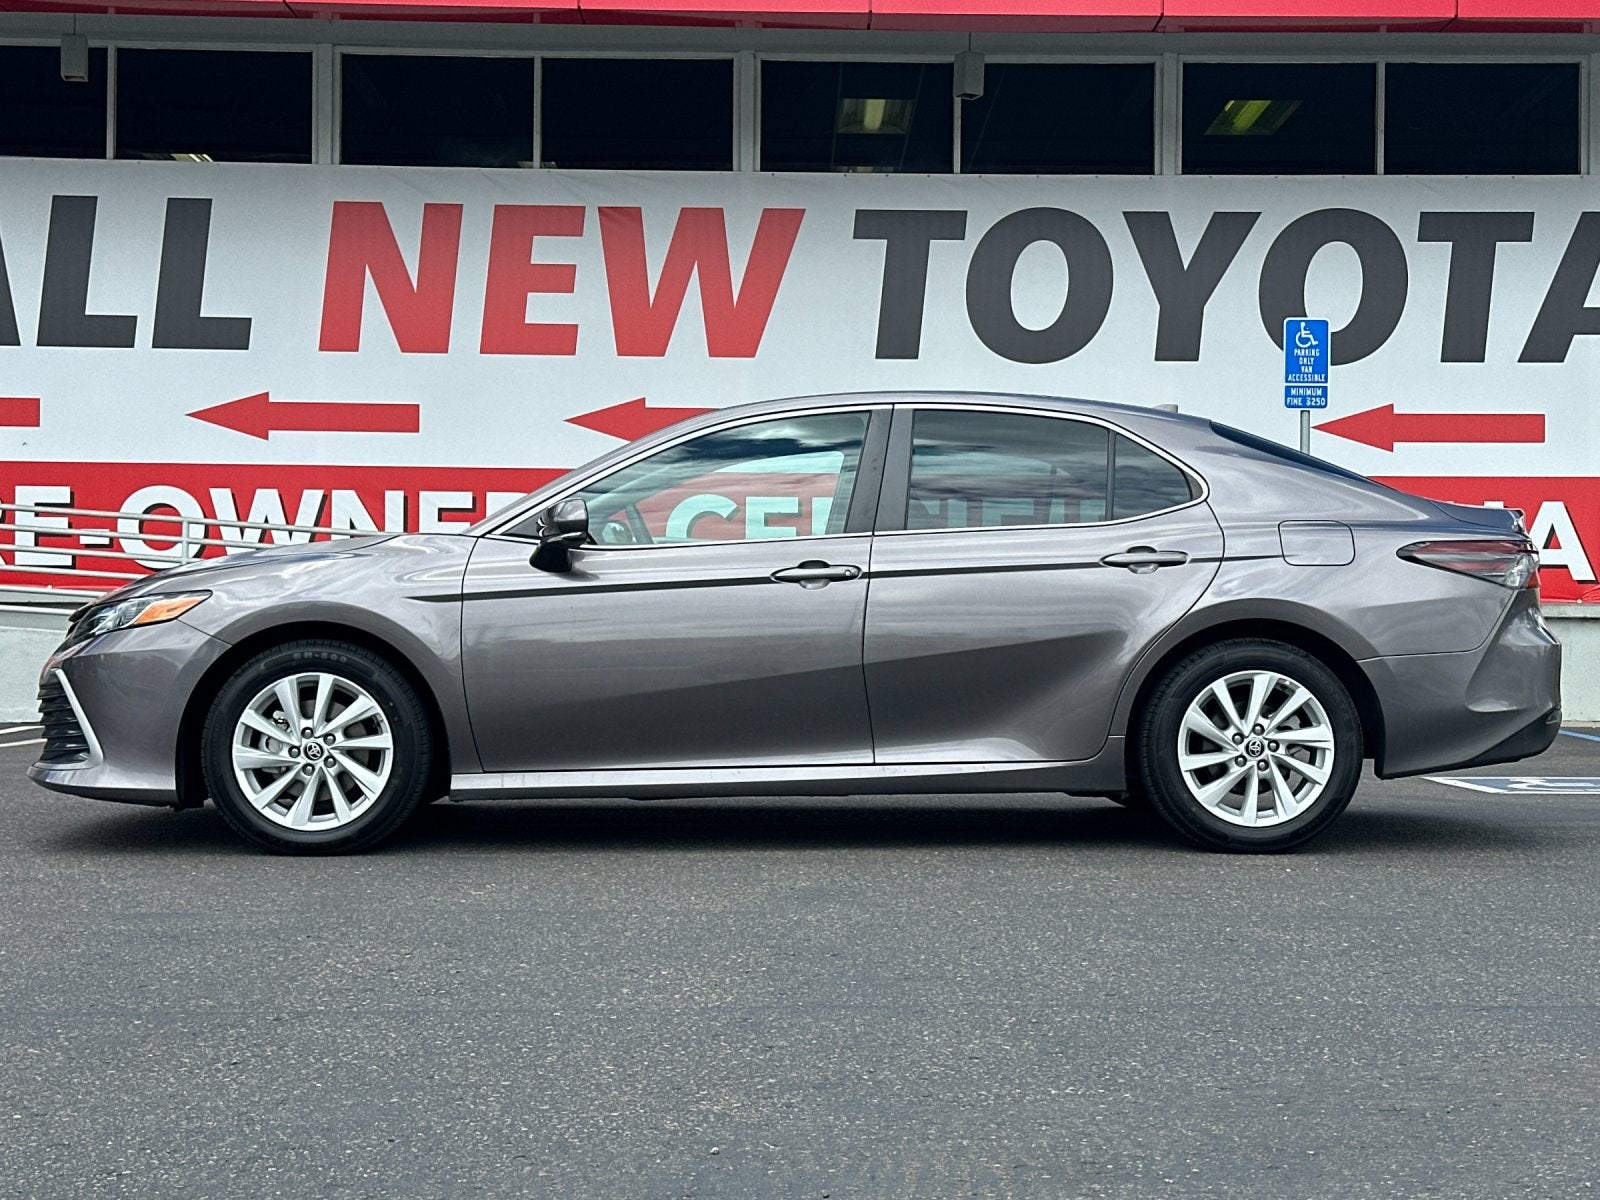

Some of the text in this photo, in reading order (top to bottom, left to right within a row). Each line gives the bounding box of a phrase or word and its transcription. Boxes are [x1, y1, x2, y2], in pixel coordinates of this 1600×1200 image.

[0, 195, 251, 349] LL
[319, 201, 804, 358] NEW
[1288, 374, 1325, 382] ACCESSIBLE
[1291, 388, 1322, 396] MINIMUM
